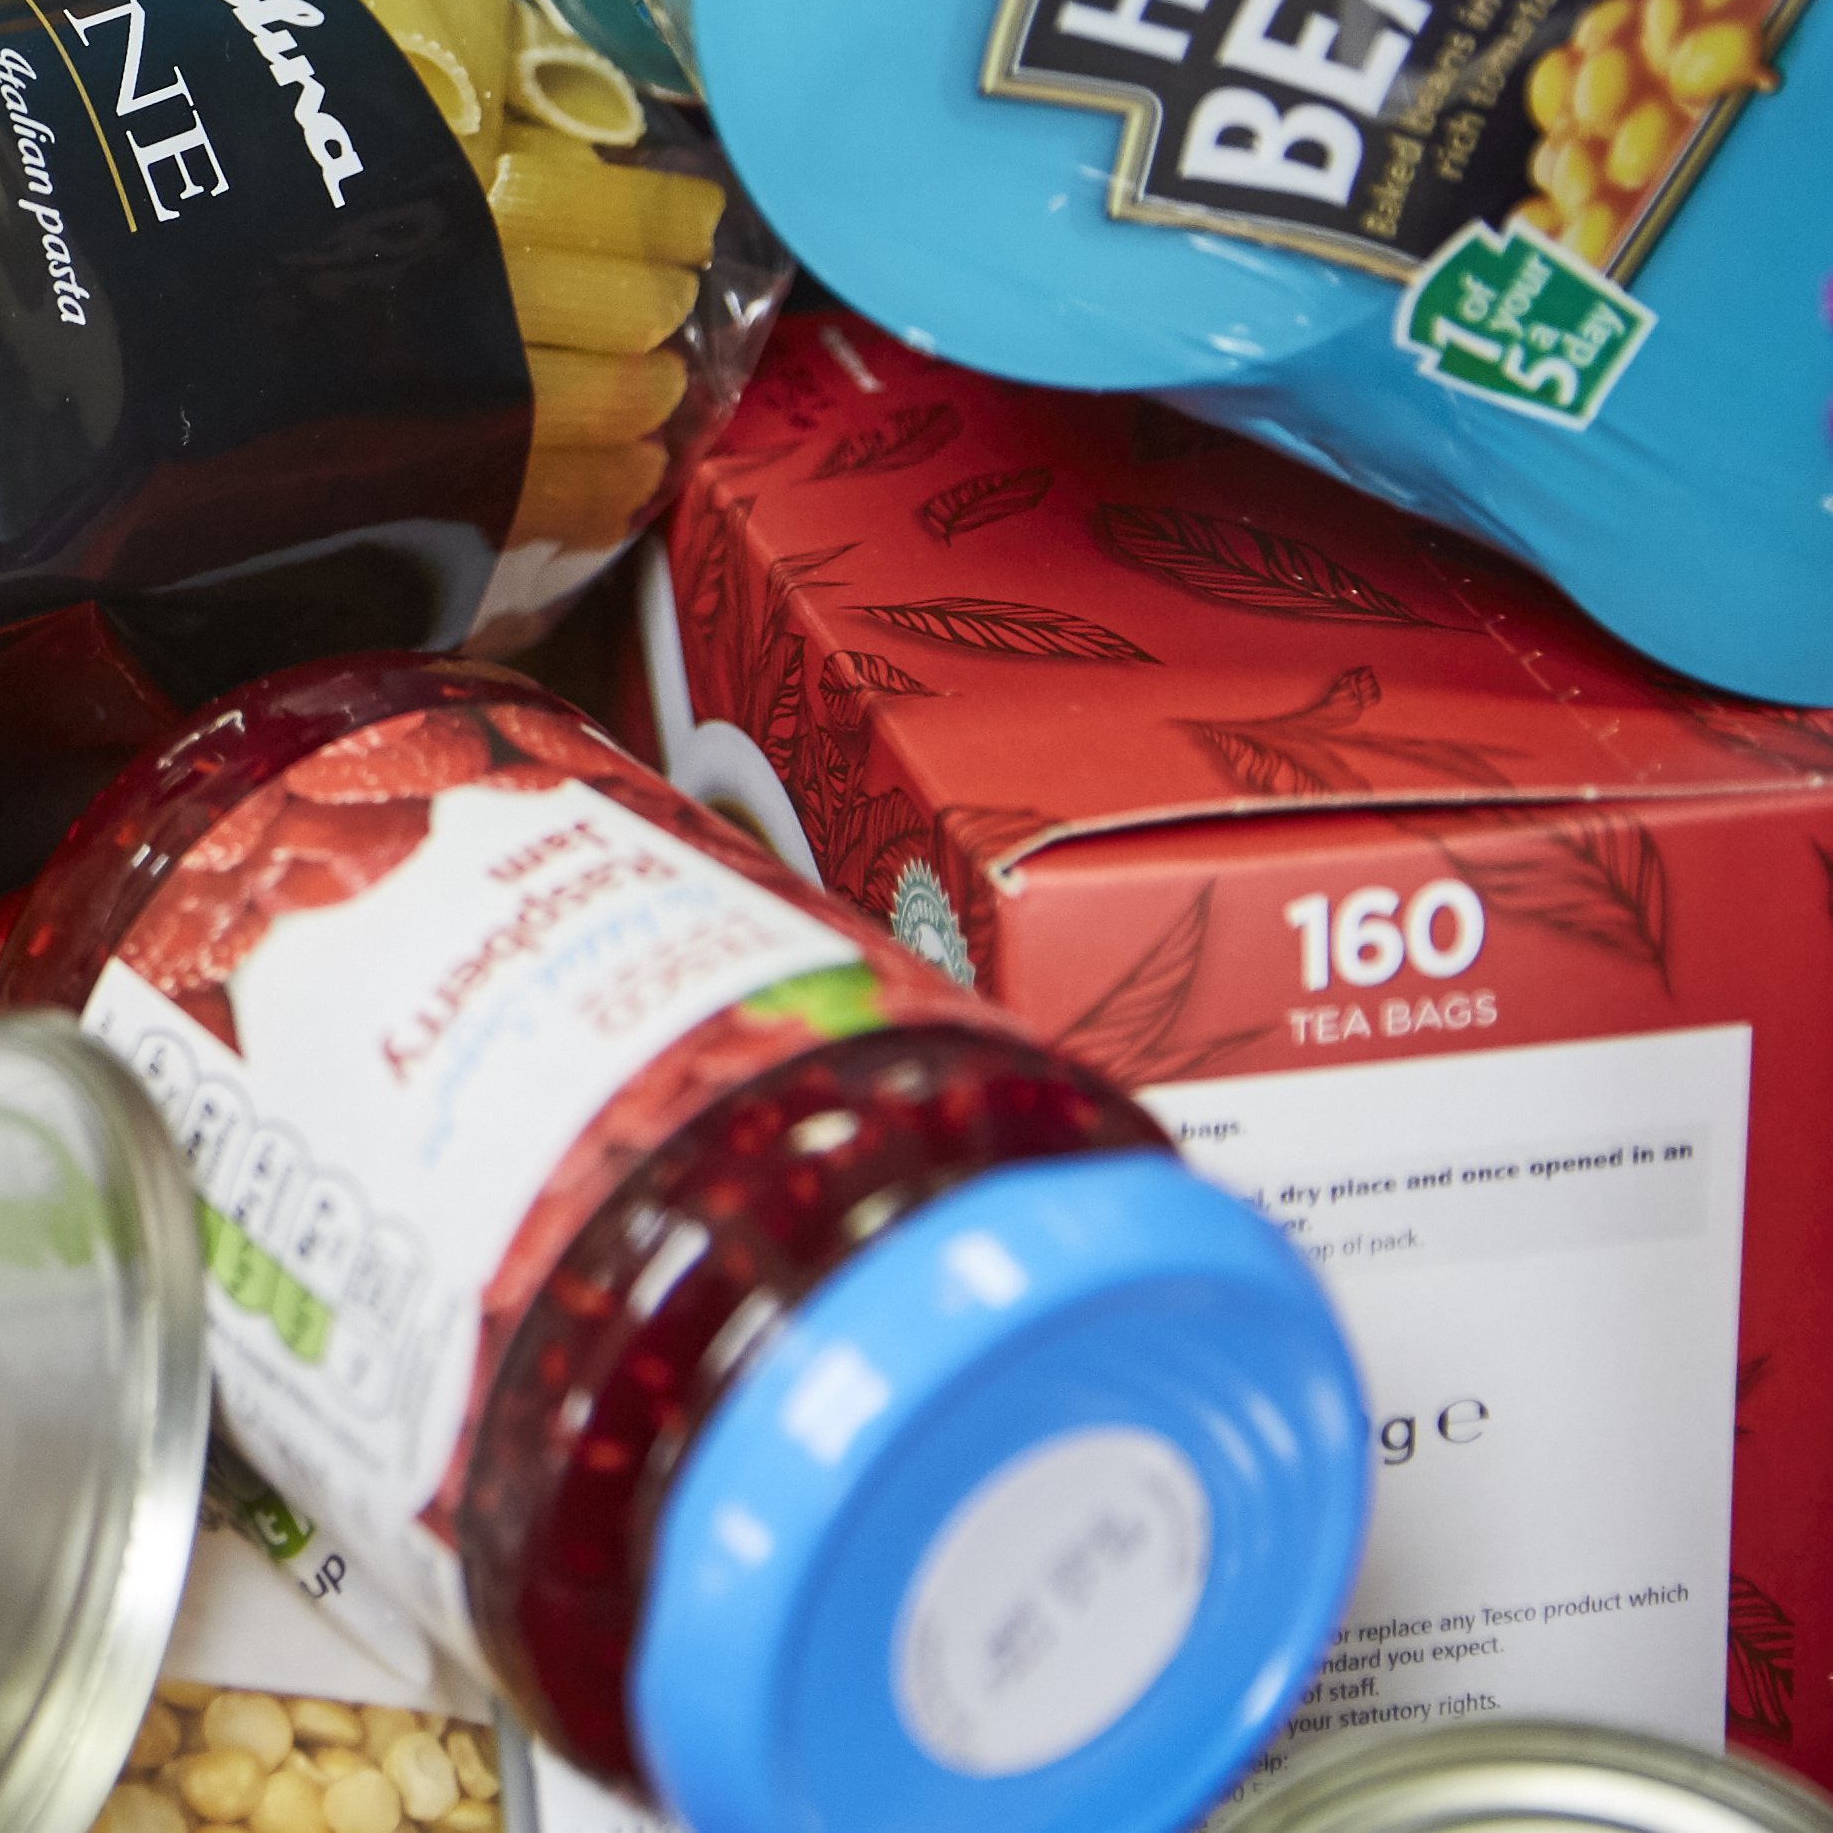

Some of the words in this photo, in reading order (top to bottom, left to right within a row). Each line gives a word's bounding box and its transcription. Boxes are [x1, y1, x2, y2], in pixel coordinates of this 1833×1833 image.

[1361, 133, 1425, 241] Baked
[1396, 30, 1478, 137] beans
[1435, 110, 1487, 182] rich
[17, 187, 91, 327] pasta
[1457, 269, 1498, 325] of
[1487, 251, 1553, 339] your
[1430, 313, 1505, 364] 1
[1527, 322, 1562, 352] a
[1562, 300, 1626, 369] day
[1502, 343, 1580, 407] 5
[489, 821, 613, 886] Jam
[1284, 878, 1486, 993] 160
[379, 849, 681, 1089] Raspberry
[1287, 1005, 1372, 1045] TEA
[1384, 992, 1499, 1037] BAGS
[1279, 1184, 1323, 1209] dry
[1330, 1176, 1399, 1205] place
[1406, 1167, 1454, 1191] and
[1460, 1162, 1521, 1185] once
[1528, 1146, 1625, 1180] opened
[1631, 1144, 1656, 1165] in
[1662, 1141, 1695, 1163] an
[1341, 1235, 1364, 1257] of
[1369, 1228, 1426, 1260] pack.
[298, 1553, 347, 1600] up
[1357, 1617, 1434, 1649] replace
[1438, 1612, 1477, 1637] any
[1480, 1604, 1537, 1628] Tesco
[1542, 1591, 1623, 1625] product
[1628, 1582, 1690, 1610] which
[1319, 1638, 1382, 1675] ndard
[1387, 1644, 1426, 1671] you
[1431, 1636, 1506, 1667] expect.
[1285, 1713, 1334, 1740] your
[1338, 1698, 1434, 1730] statutory
[1437, 1691, 1503, 1720] rights.
[1302, 1683, 1324, 1706] of
[1328, 1677, 1381, 1702] staff.
